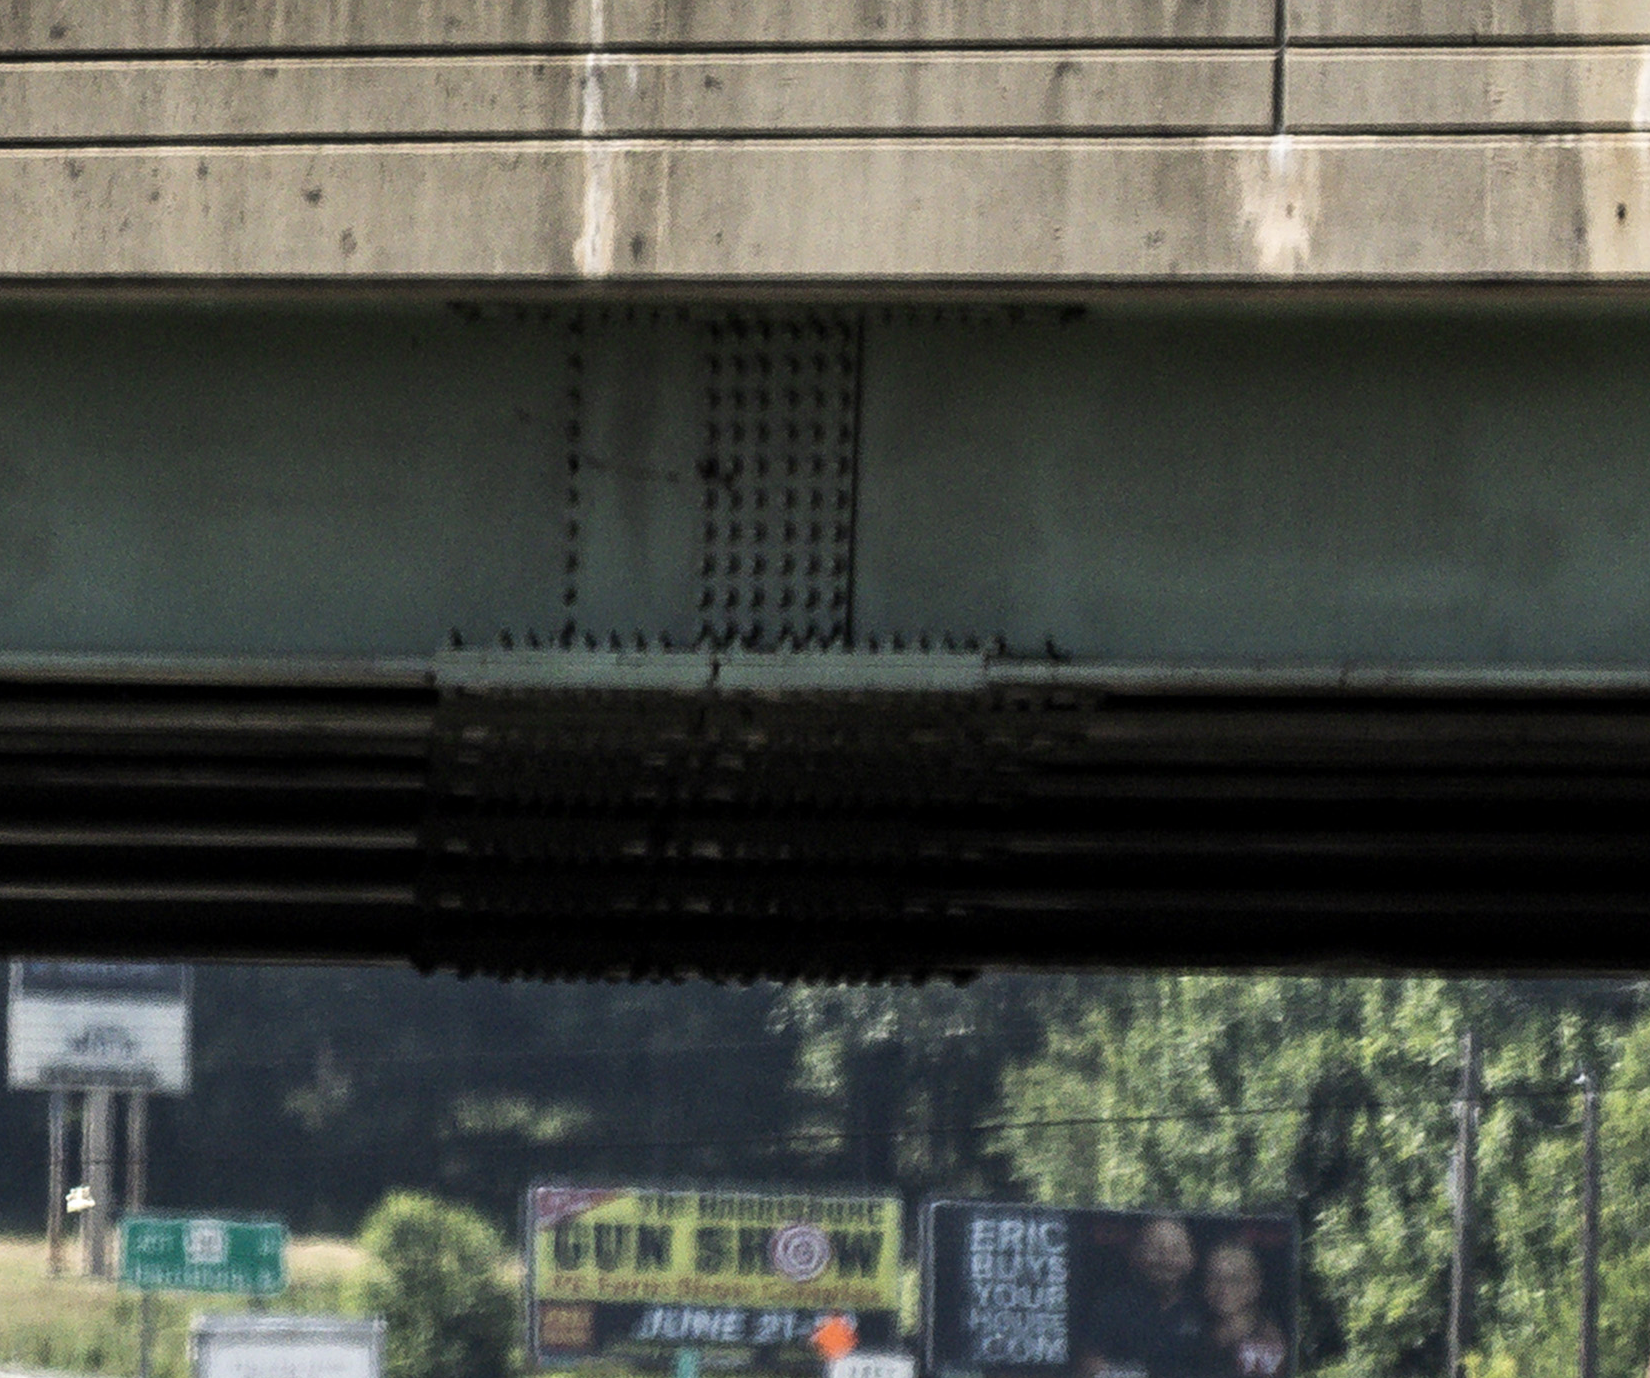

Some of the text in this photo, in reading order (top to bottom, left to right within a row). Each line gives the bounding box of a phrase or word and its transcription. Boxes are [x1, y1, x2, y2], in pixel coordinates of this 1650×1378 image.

[552, 1222, 885, 1281] GUN SHOW
[970, 1217, 1069, 1253] ERIC
[970, 1252, 1069, 1284] BUYS
[971, 1280, 1068, 1311] YOUR
[634, 1306, 746, 1344] JUNE
